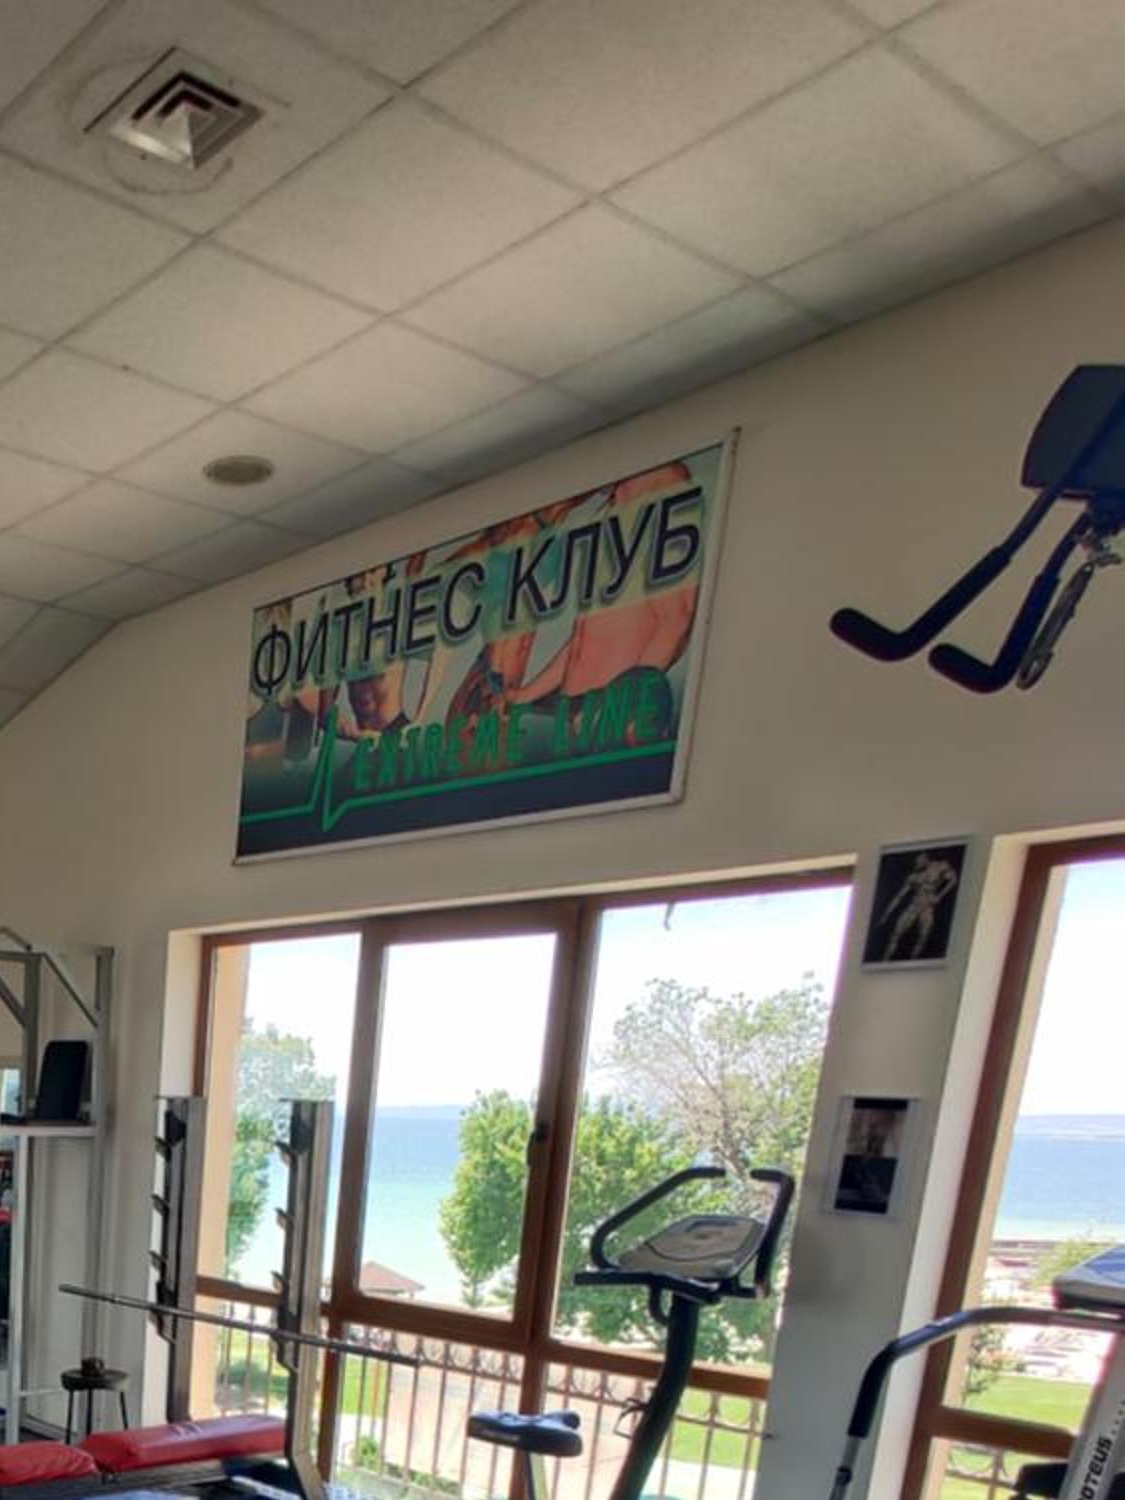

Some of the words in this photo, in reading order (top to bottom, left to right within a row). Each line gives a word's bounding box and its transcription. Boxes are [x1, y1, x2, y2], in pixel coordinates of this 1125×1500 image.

[253, 561, 485, 694] ФИТНЕС
[507, 486, 703, 620] КЛУБ
[352, 704, 527, 790] EXTREME
[555, 677, 661, 753] LINE
